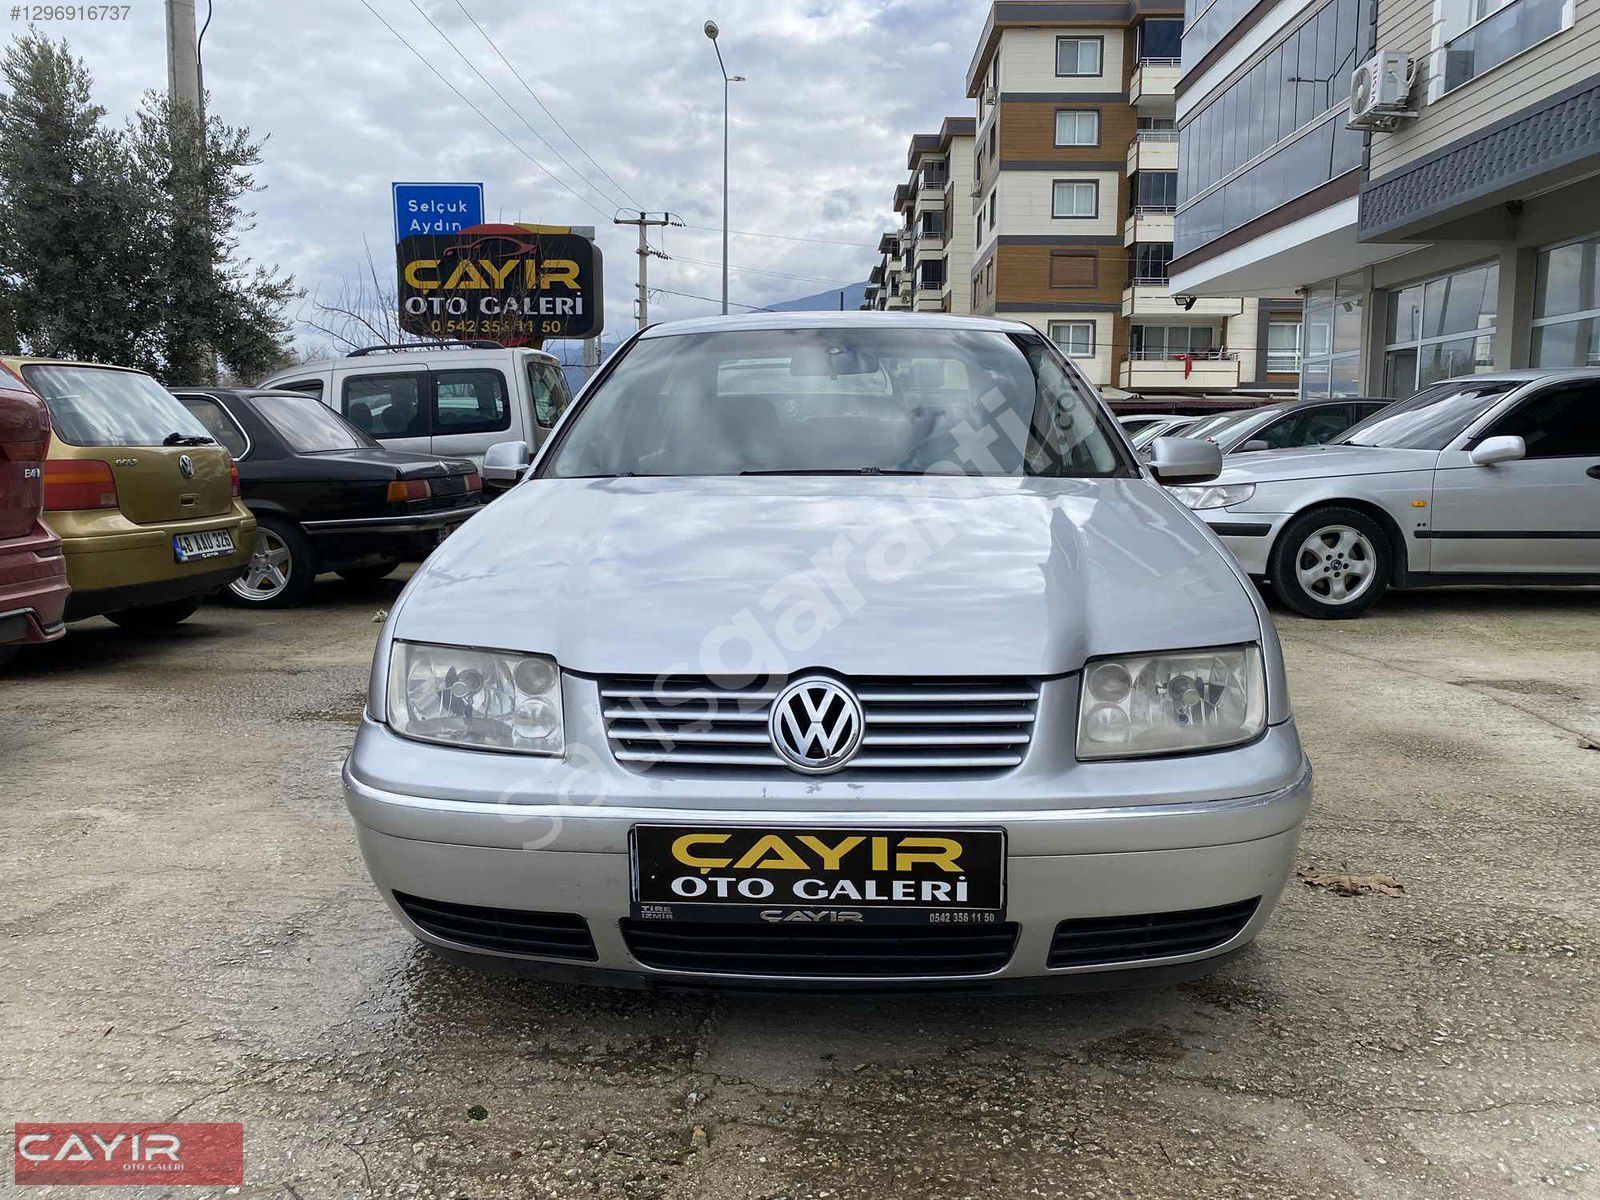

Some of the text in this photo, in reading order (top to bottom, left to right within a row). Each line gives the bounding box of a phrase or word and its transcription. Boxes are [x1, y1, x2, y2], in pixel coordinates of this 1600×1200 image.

[408, 199, 467, 213] Selçuk
[410, 219, 461, 235] Aydın
[404, 259, 582, 295] ÇAYIR
[405, 292, 583, 315] OTO GALERİ
[447, 320, 476, 333] 542
[481, 320, 511, 333] 35
[541, 320, 561, 333] 50
[671, 833, 965, 873] ÇAYIR
[671, 876, 968, 902] OTO GALERİ
[760, 910, 995, 923] ÇAYIR 0542 356 11 50
